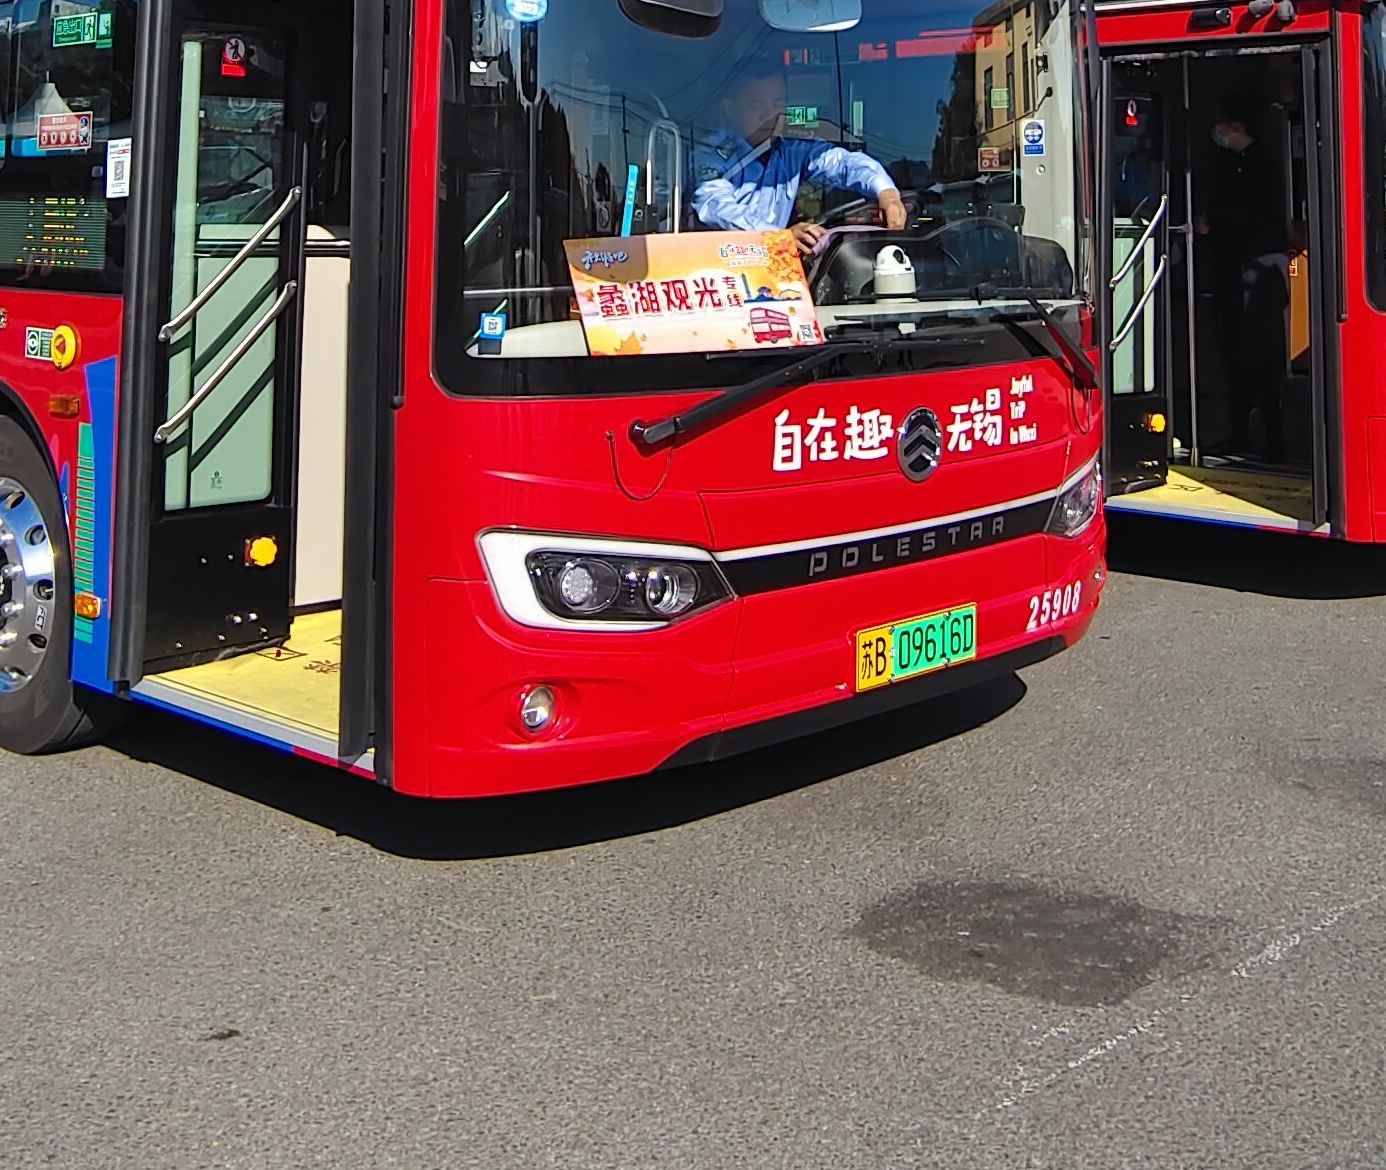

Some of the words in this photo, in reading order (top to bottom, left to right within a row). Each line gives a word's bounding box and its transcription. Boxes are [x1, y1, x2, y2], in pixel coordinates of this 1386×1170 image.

[773, 405, 895, 471] 自在趣
[946, 388, 1003, 452] 无锡
[808, 515, 1005, 576] POLESTAR
[1026, 580, 1082, 631] 25908
